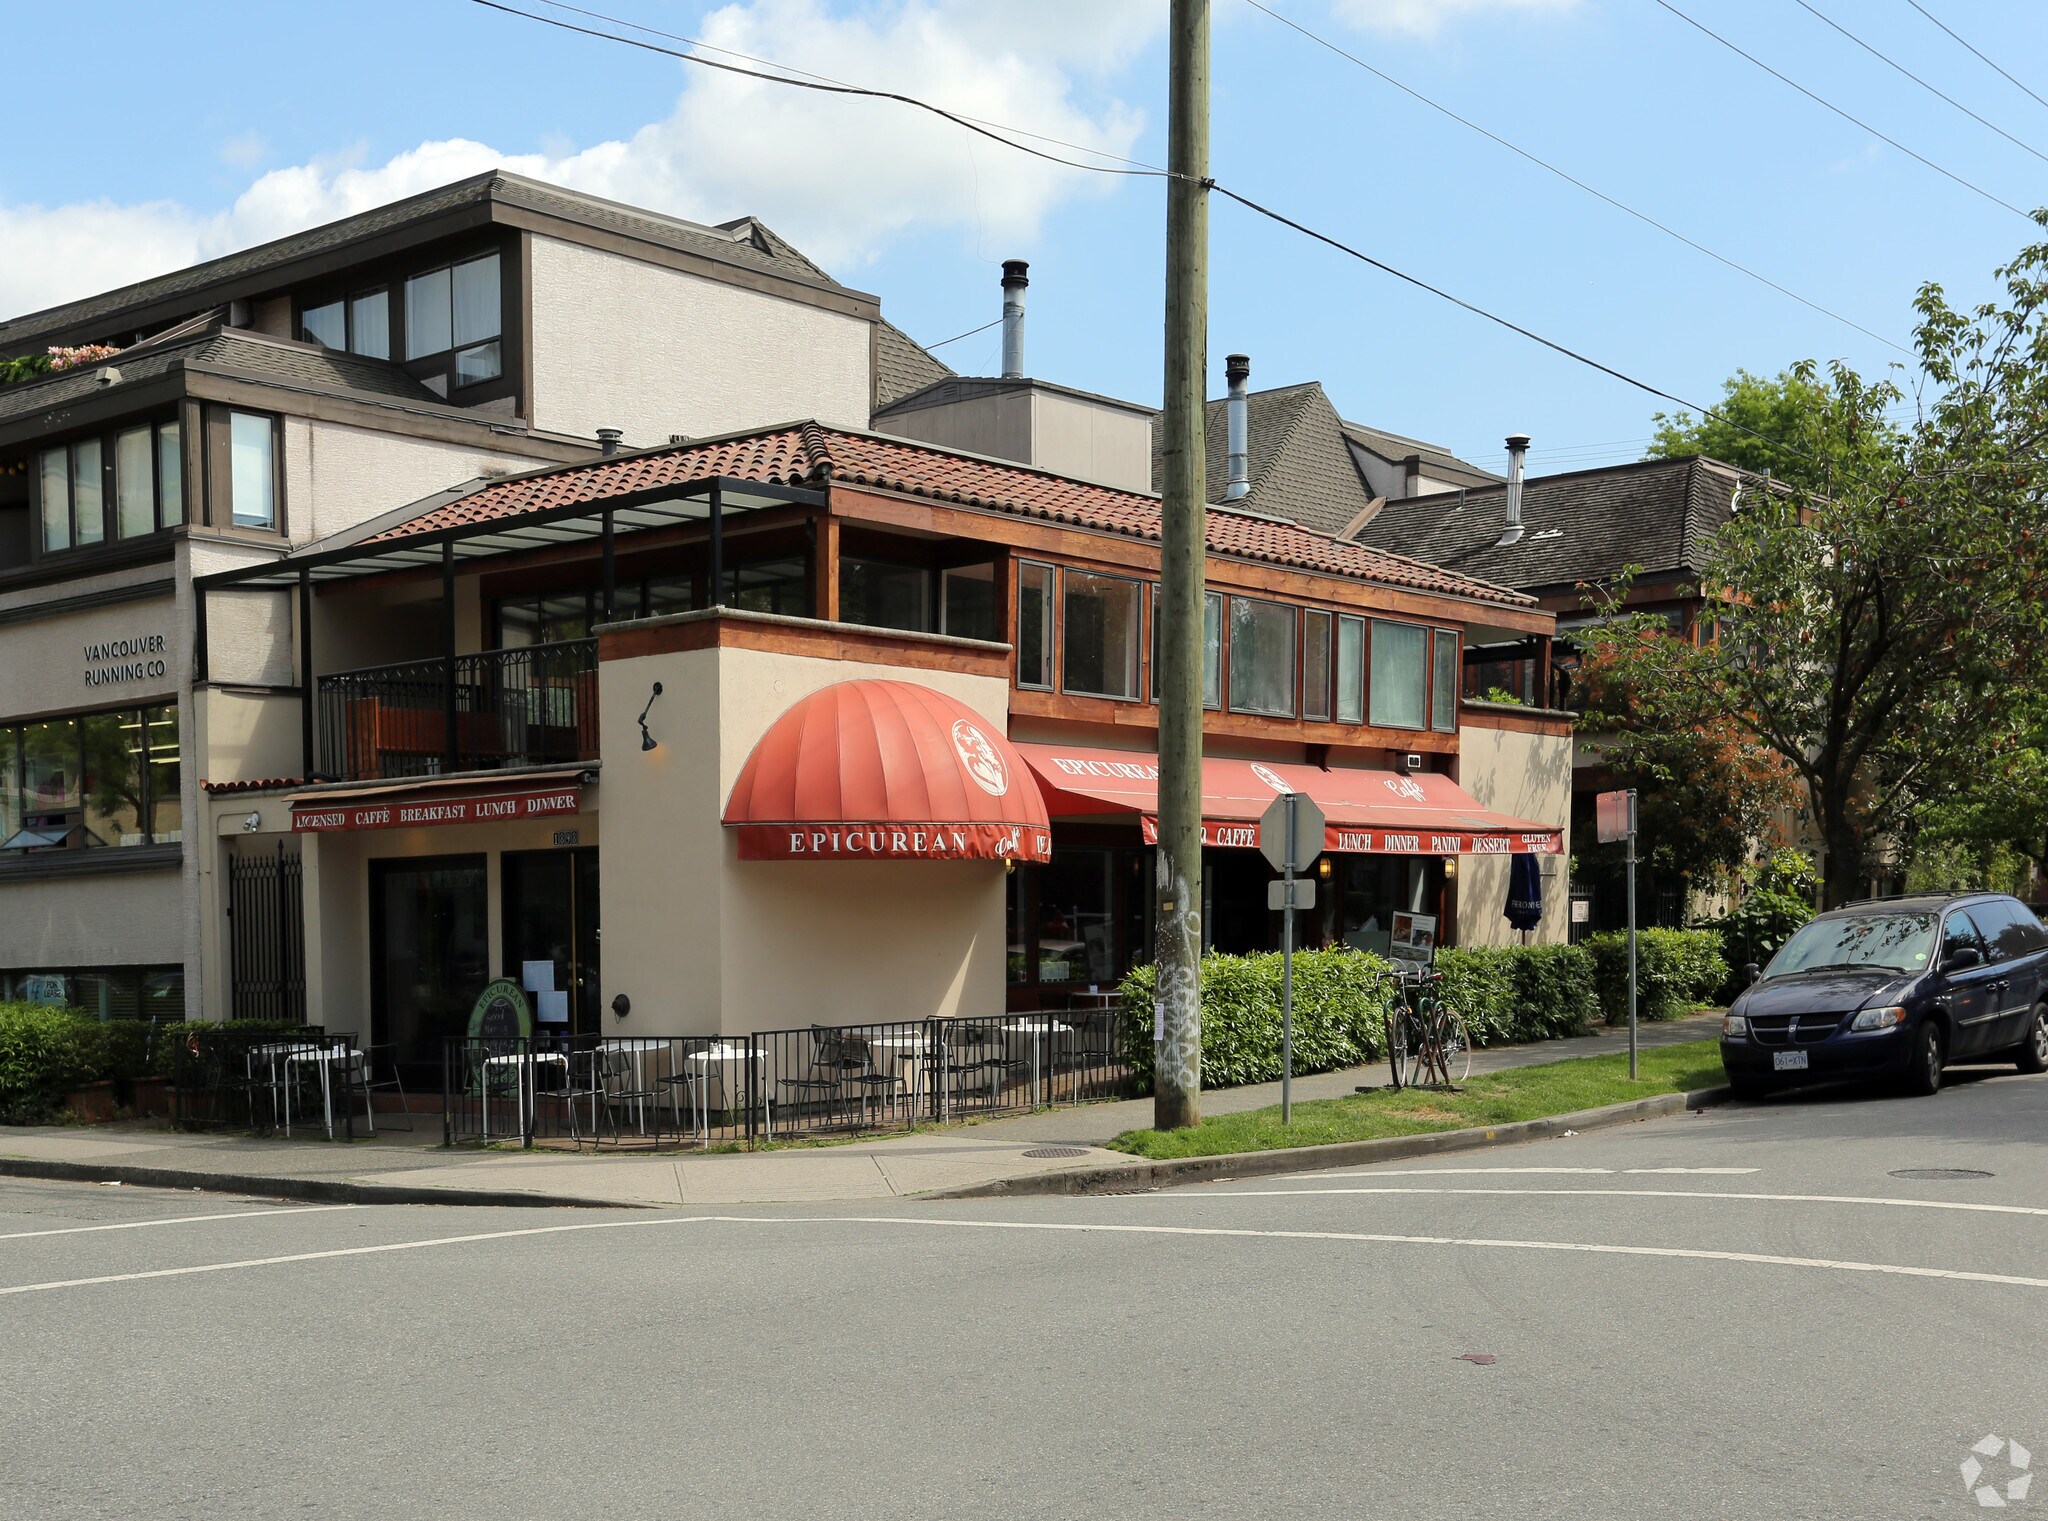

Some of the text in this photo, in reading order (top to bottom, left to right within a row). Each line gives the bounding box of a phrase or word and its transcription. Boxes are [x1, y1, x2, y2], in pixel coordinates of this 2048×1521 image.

[84, 635, 166, 662] VANCOUVER
[85, 660, 165, 686] RUNNING CO
[1050, 758, 1159, 780] EPICUREA
[296, 813, 345, 828] LICENSED
[400, 805, 466, 822] BREAKFAST
[476, 801, 516, 817] LUNCH
[527, 795, 576, 812] DINNER
[789, 832, 966, 853] EPICUREAN
[1338, 833, 1372, 851] LUNCH
[1384, 834, 1419, 852] DINNER
[1431, 836, 1461, 853] PANINI
[1471, 837, 1511, 853] DESSERT
[1521, 833, 1551, 843] GLUTEN
[478, 985, 524, 1009] EPICUREAN
